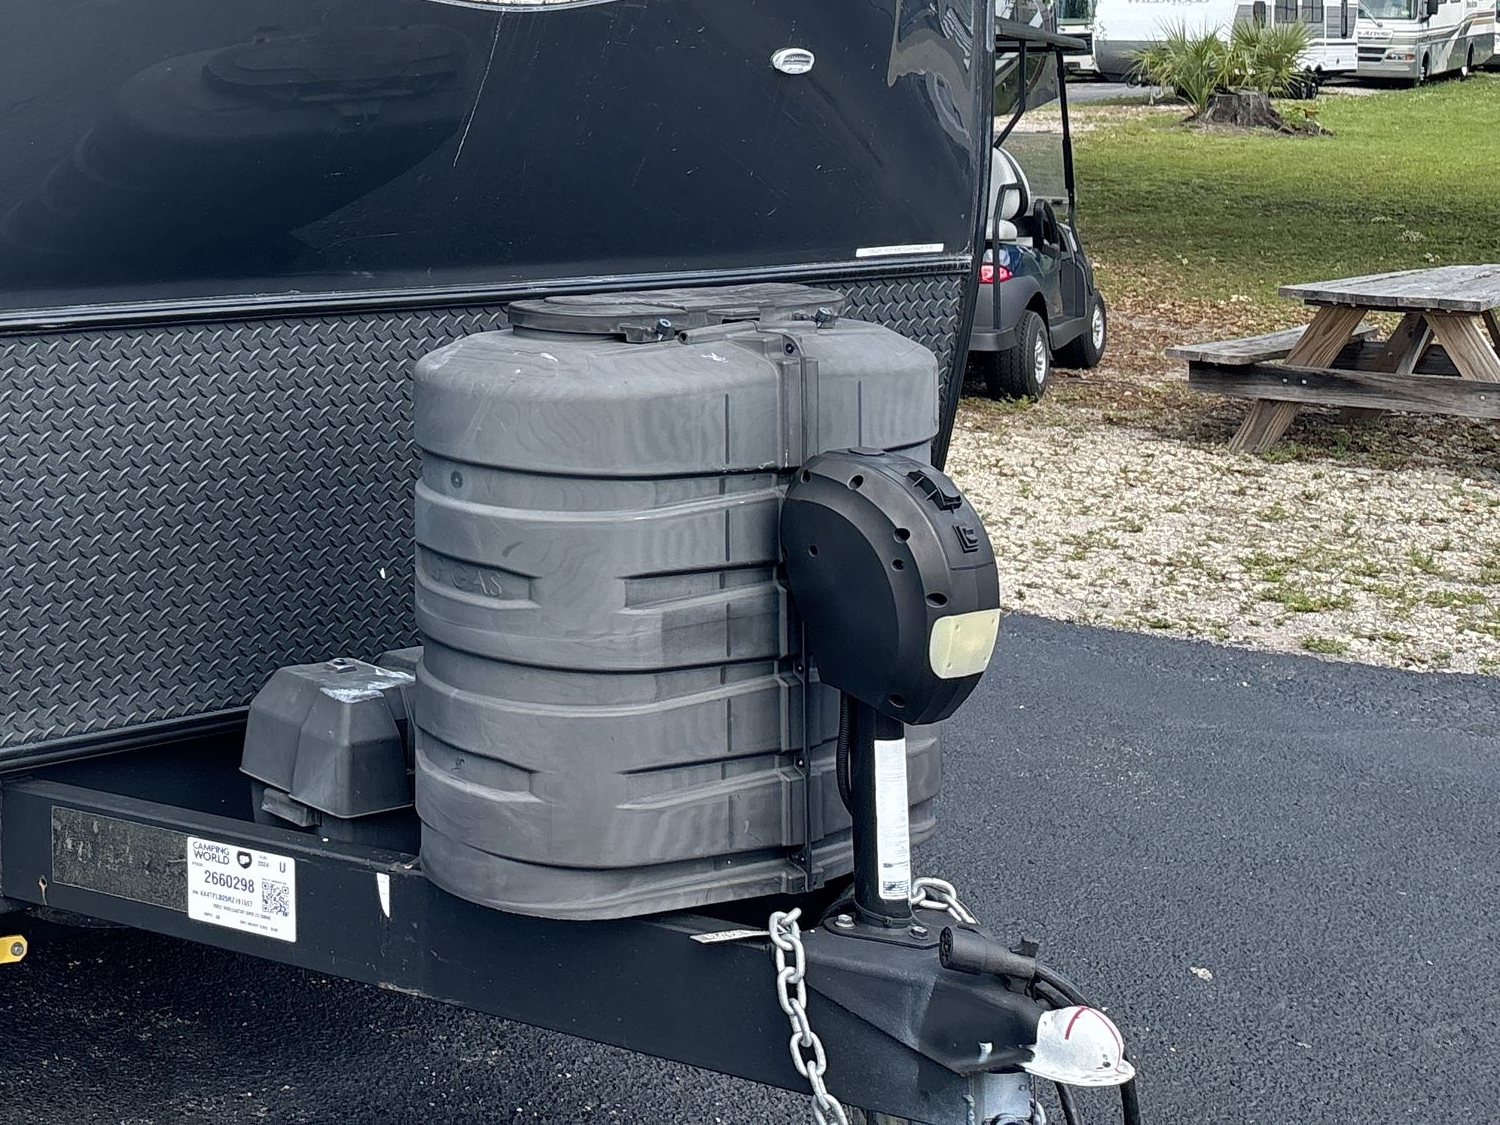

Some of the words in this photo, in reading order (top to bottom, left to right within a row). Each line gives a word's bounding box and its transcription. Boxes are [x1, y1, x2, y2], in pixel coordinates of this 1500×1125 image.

[192, 841, 230, 856] CAMPING
[193, 849, 230, 865] WORLD
[279, 861, 286, 873] U
[204, 869, 255, 893] 2660298
